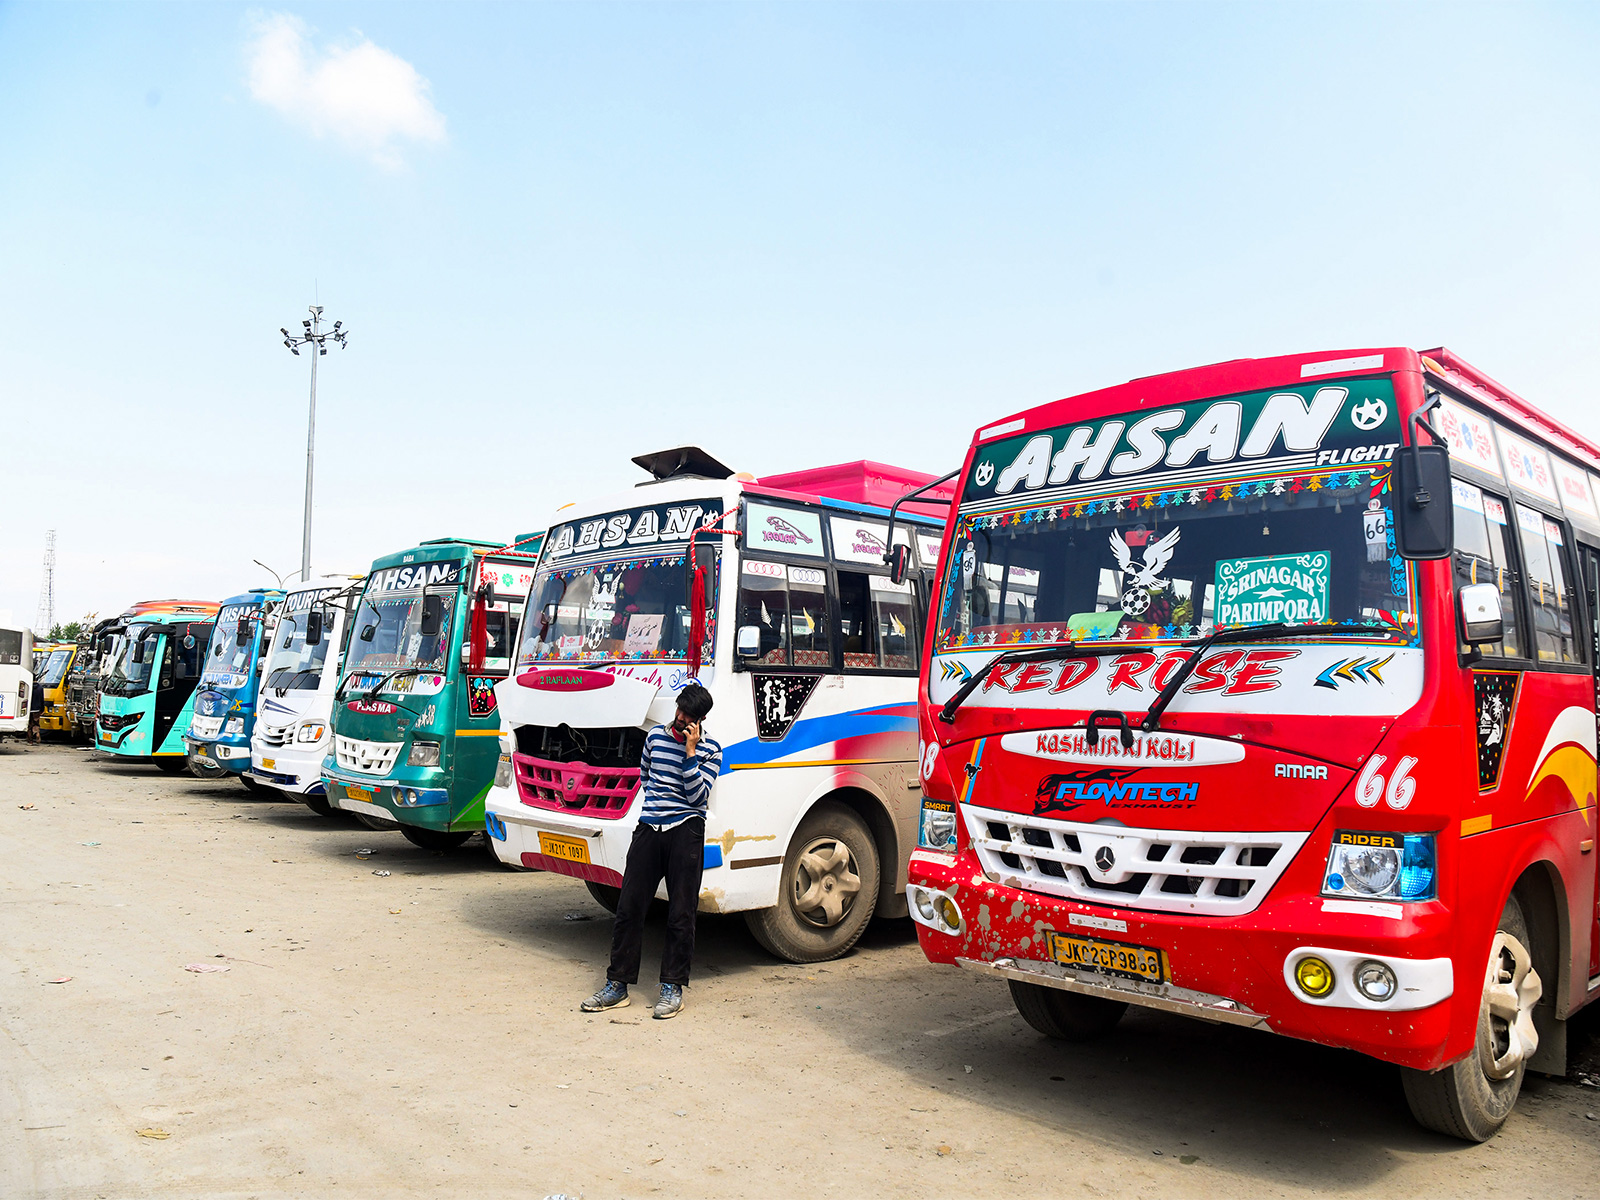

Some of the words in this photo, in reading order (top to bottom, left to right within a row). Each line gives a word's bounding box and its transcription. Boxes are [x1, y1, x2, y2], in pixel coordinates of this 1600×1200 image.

[995, 386, 1349, 495] AHSAN
[1315, 442, 1399, 466] FLIGHT
[549, 505, 704, 557] AHSAN
[762, 530, 798, 545] JAGUAR
[1366, 518, 1385, 540] 66
[852, 543, 882, 556] JAGUAR
[370, 564, 451, 592] AHSAN
[1227, 566, 1315, 602] SRINAGAR
[219, 605, 256, 623] AHSAN
[1221, 598, 1322, 624] PARIMPORA
[540, 675, 545, 685] 2
[982, 656, 1102, 696] RED
[1106, 649, 1302, 697] ROSE
[1274, 763, 1329, 780] AMAR
[1355, 753, 1419, 810] 66
[1055, 780, 1200, 806] FLOWTECH
[924, 801, 952, 812] SMART
[548, 842, 566, 856] JK21C
[568, 846, 583, 859] 1097
[1340, 833, 1395, 848] RIDER
